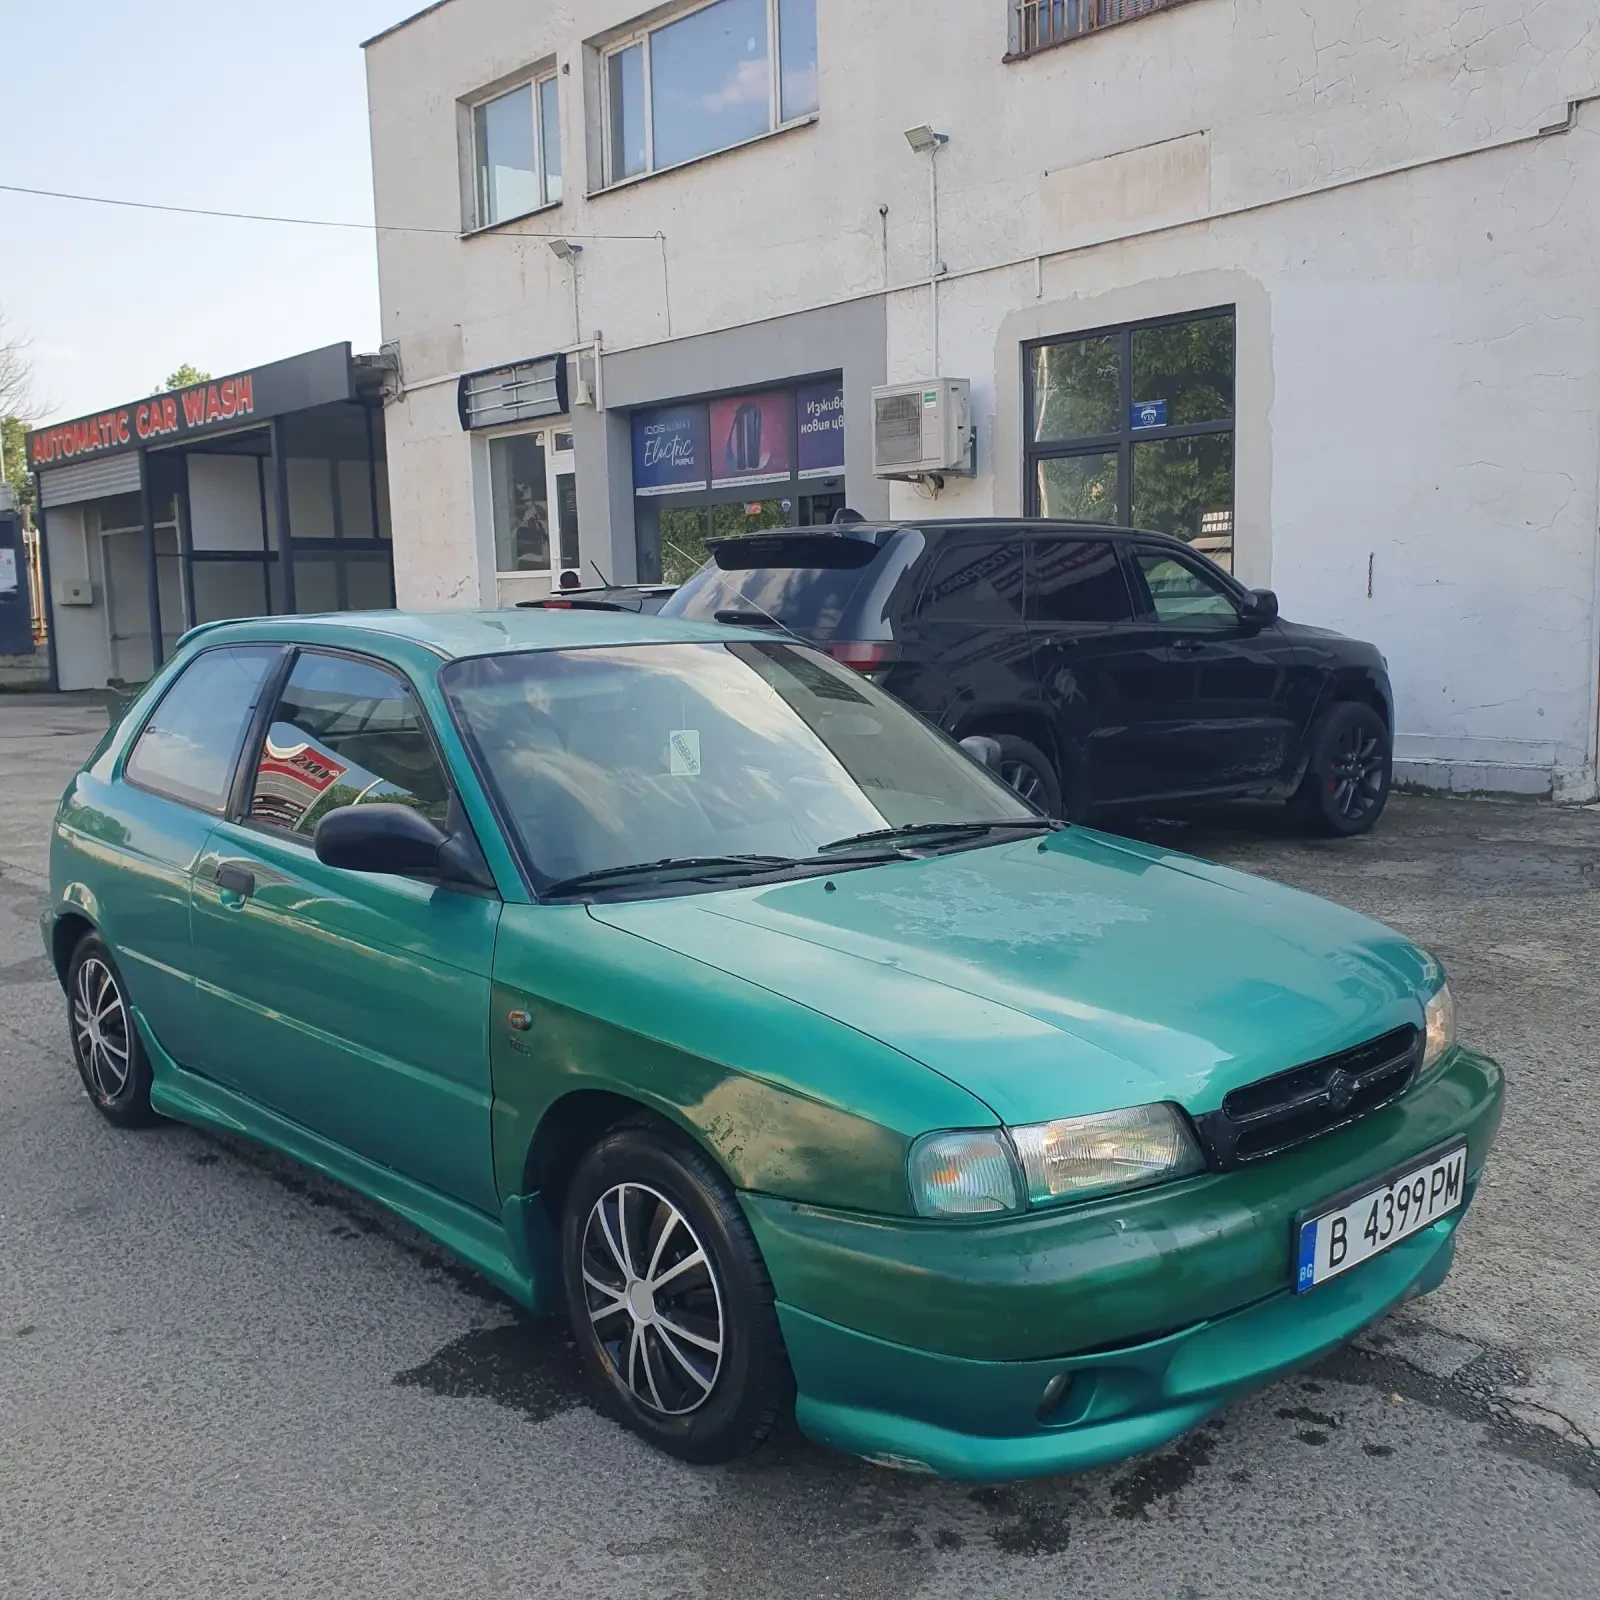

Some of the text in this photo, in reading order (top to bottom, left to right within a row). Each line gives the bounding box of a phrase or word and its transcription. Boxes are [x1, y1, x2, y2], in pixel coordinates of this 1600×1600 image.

[33, 375, 254, 464] AUTOMATIC CAR WASH
[801, 419, 830, 434] новия
[645, 434, 694, 467] Electric
[675, 457, 695, 466] PURPLE
[1329, 1216, 1348, 1268] B
[1299, 1263, 1313, 1282] BG
